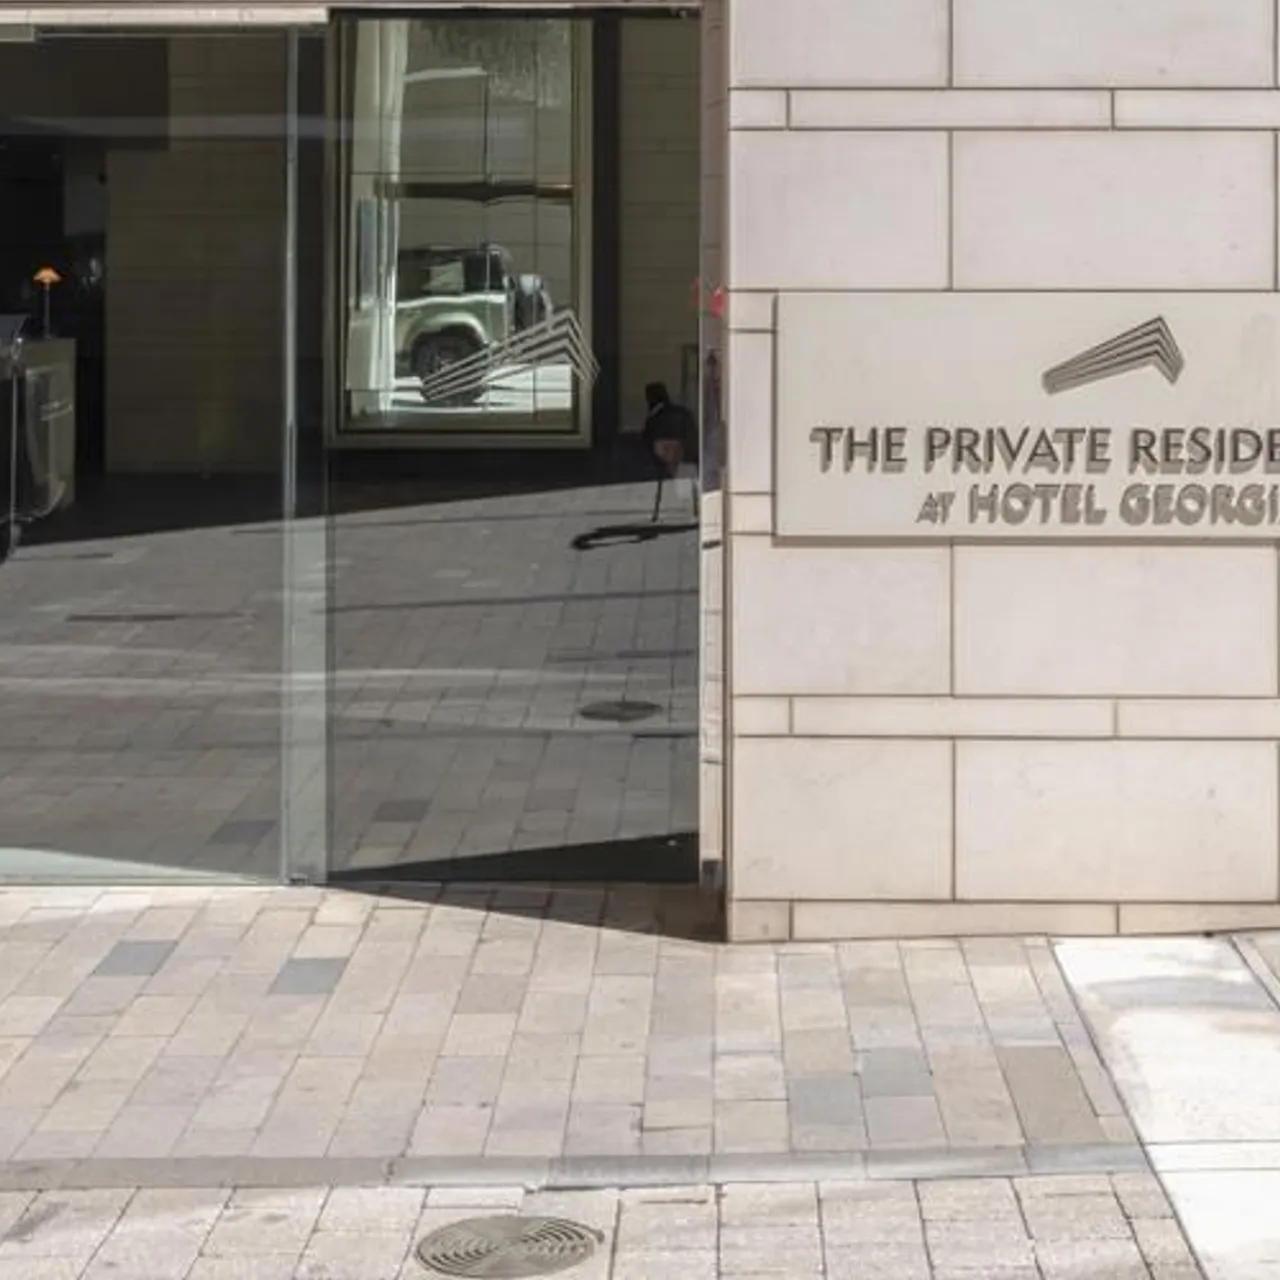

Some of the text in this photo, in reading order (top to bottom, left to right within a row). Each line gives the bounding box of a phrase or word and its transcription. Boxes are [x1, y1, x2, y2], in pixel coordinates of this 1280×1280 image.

[811, 426, 908, 467] THE
[925, 426, 1111, 467] PRIVATE
[968, 482, 1106, 522] HOTEL
